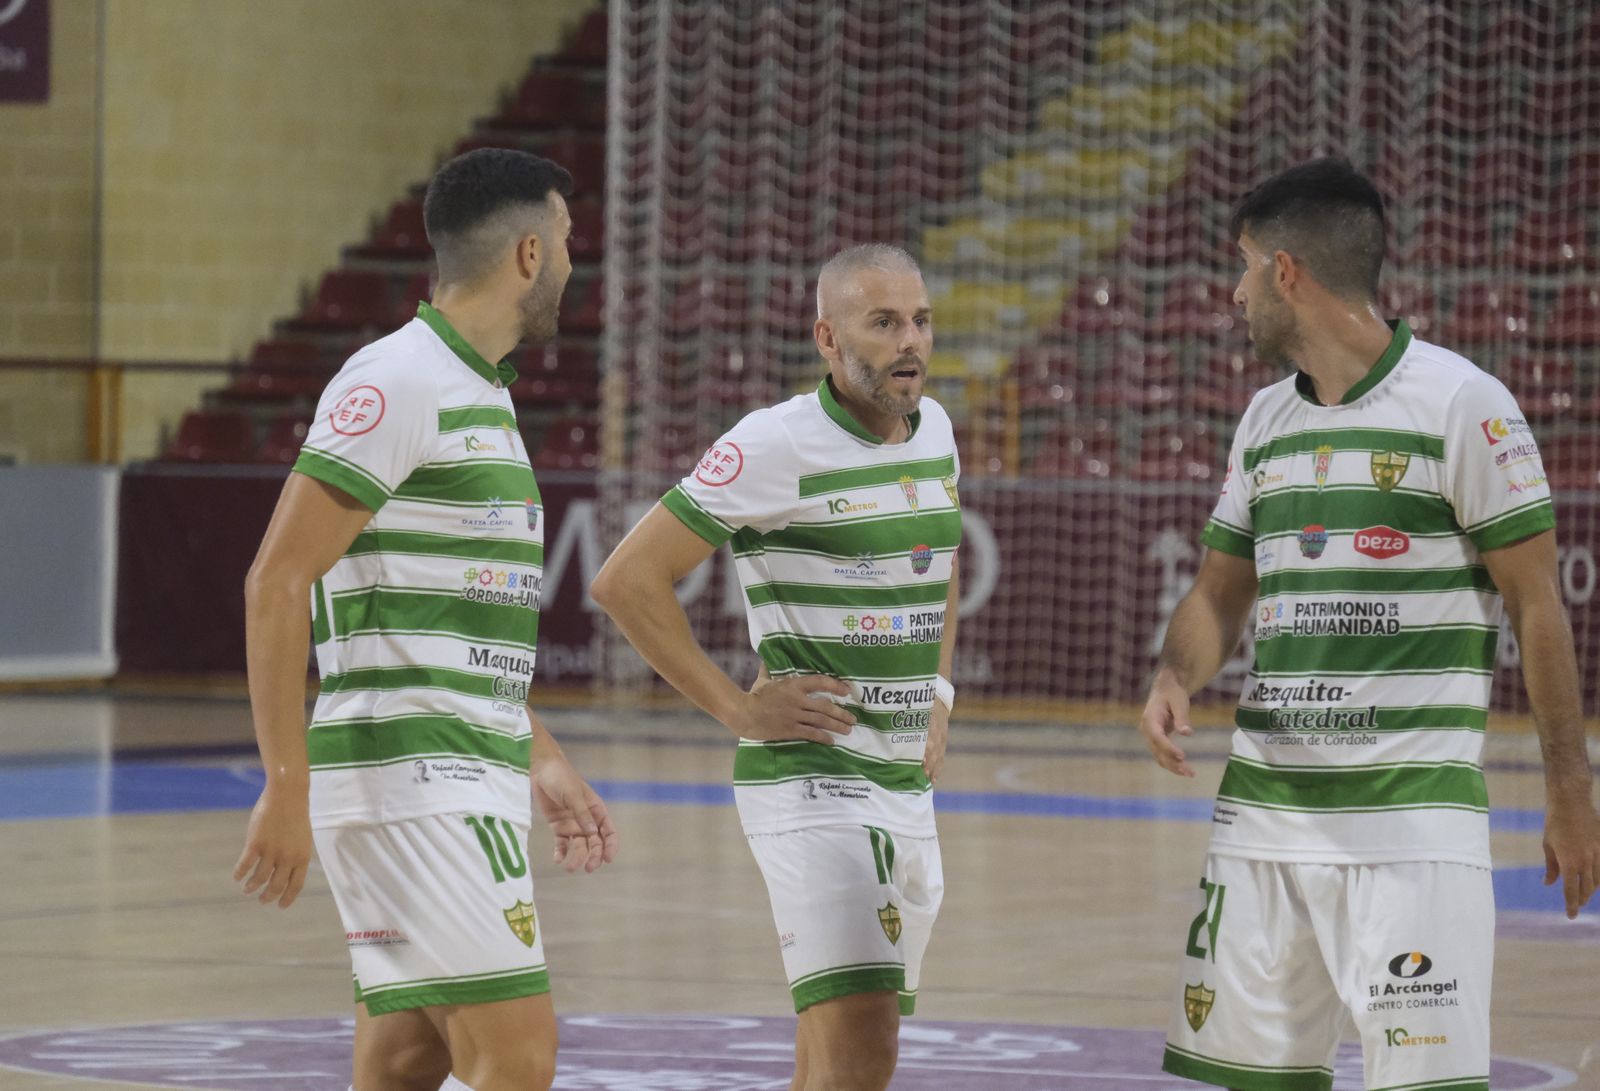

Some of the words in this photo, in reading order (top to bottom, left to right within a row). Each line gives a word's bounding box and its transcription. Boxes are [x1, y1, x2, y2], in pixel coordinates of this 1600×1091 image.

[827, 498, 849, 515] 10
[844, 502, 878, 513] METROS
[1295, 602, 1386, 617] PATRIMONIO
[1293, 618, 1400, 636] HUMANIDAD
[842, 631, 904, 646] CÓRDOBA
[1269, 705, 1377, 729] Catedral
[1308, 734, 1321, 746] de
[1324, 732, 1378, 746] Córdoba
[464, 815, 527, 884] 10
[1369, 984, 1380, 997] El
[1383, 978, 1458, 996] Arcángel
[1367, 1000, 1403, 1012] CENTRO
[1406, 997, 1460, 1010] COMERCIAL
[1384, 1027, 1409, 1047] 10
[1401, 1035, 1447, 1047] METROS
